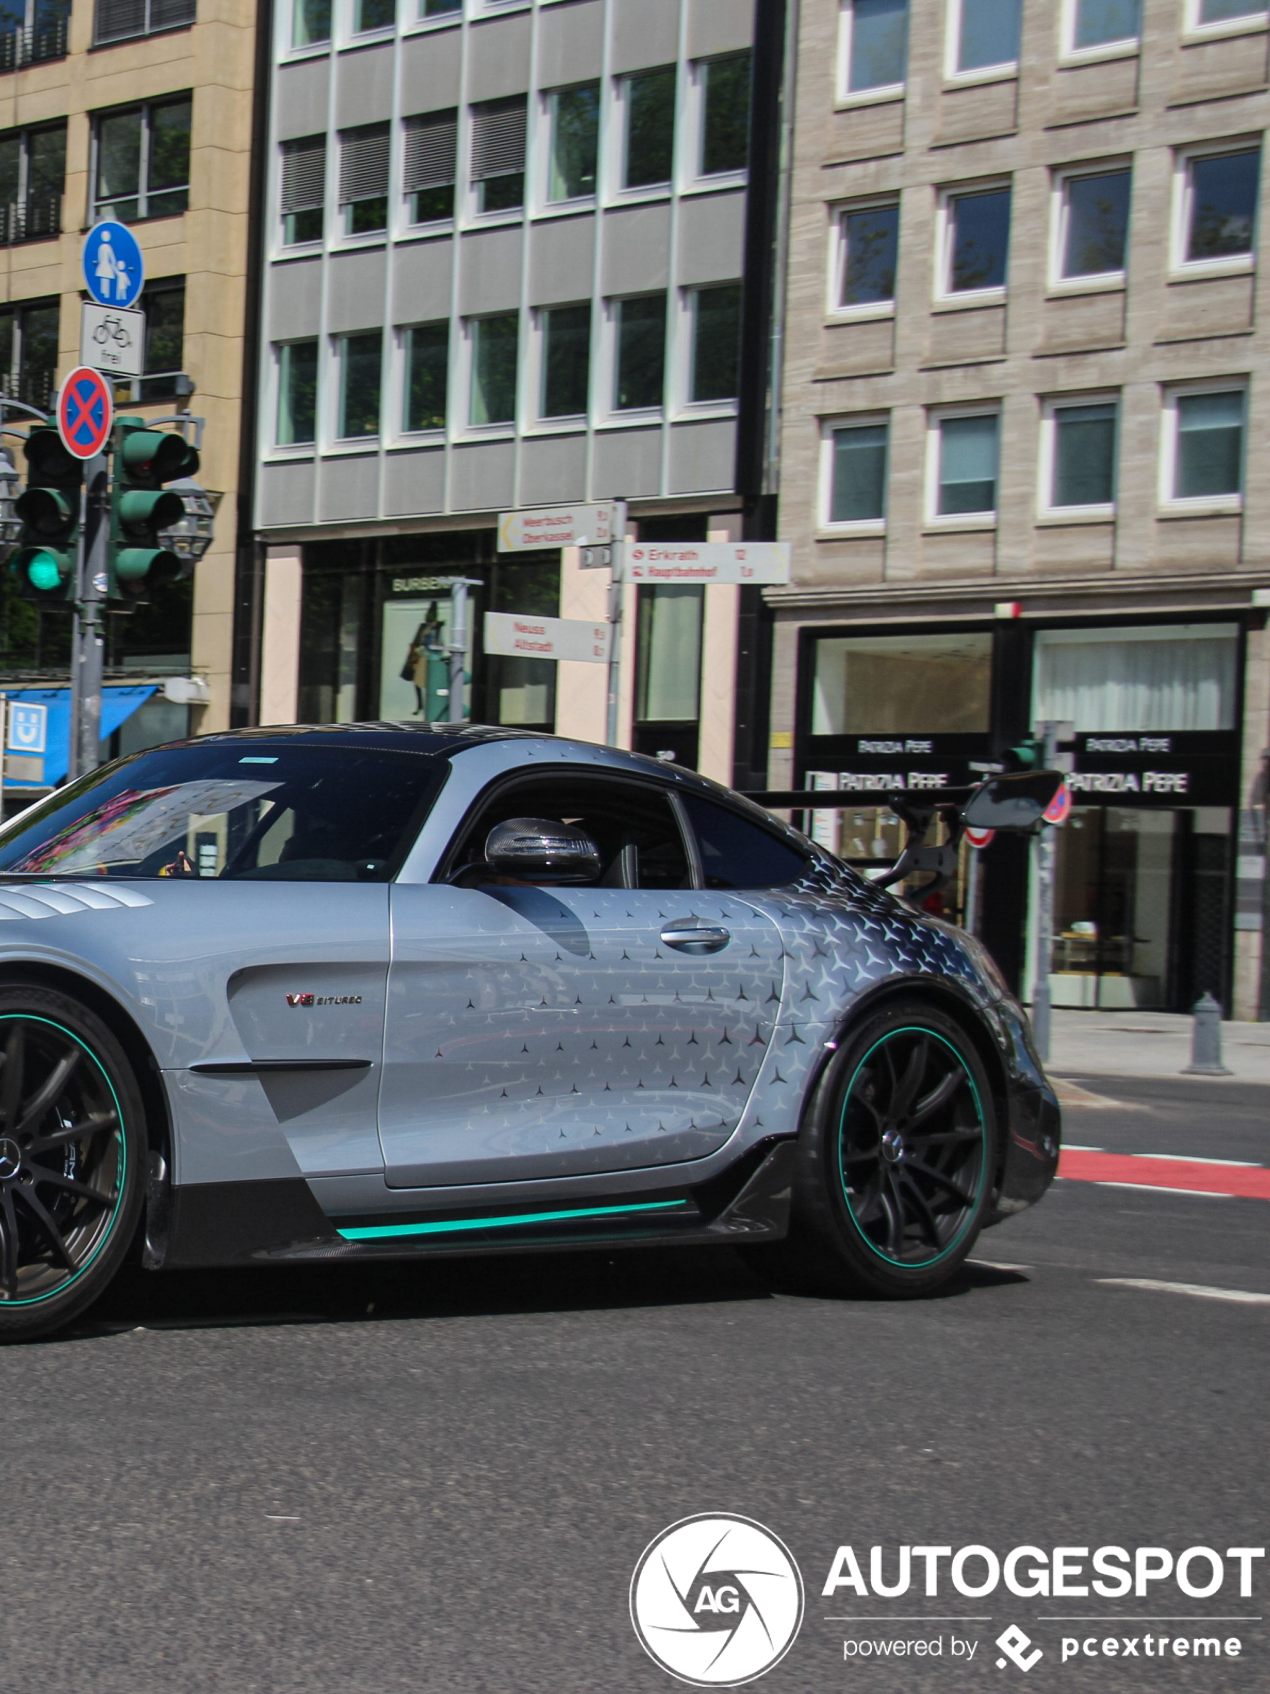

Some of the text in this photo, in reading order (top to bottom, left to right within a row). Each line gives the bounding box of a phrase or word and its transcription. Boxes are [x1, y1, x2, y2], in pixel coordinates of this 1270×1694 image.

[101, 349, 121, 365] frei
[522, 514, 573, 527] Meerbusch
[522, 531, 574, 544] Oberkassel
[648, 549, 699, 561] Erkrath
[648, 565, 718, 579] Hauptbahnhof
[513, 621, 546, 635] Neuss
[514, 639, 553, 652] Altstadt
[858, 740, 932, 753] PATRIZIA PEPE
[1086, 737, 1170, 752] PATRIZIA PEPE
[839, 772, 905, 789] PATRIZIA
[1142, 771, 1188, 793] PEPE
[316, 995, 363, 1005] BITURBO
